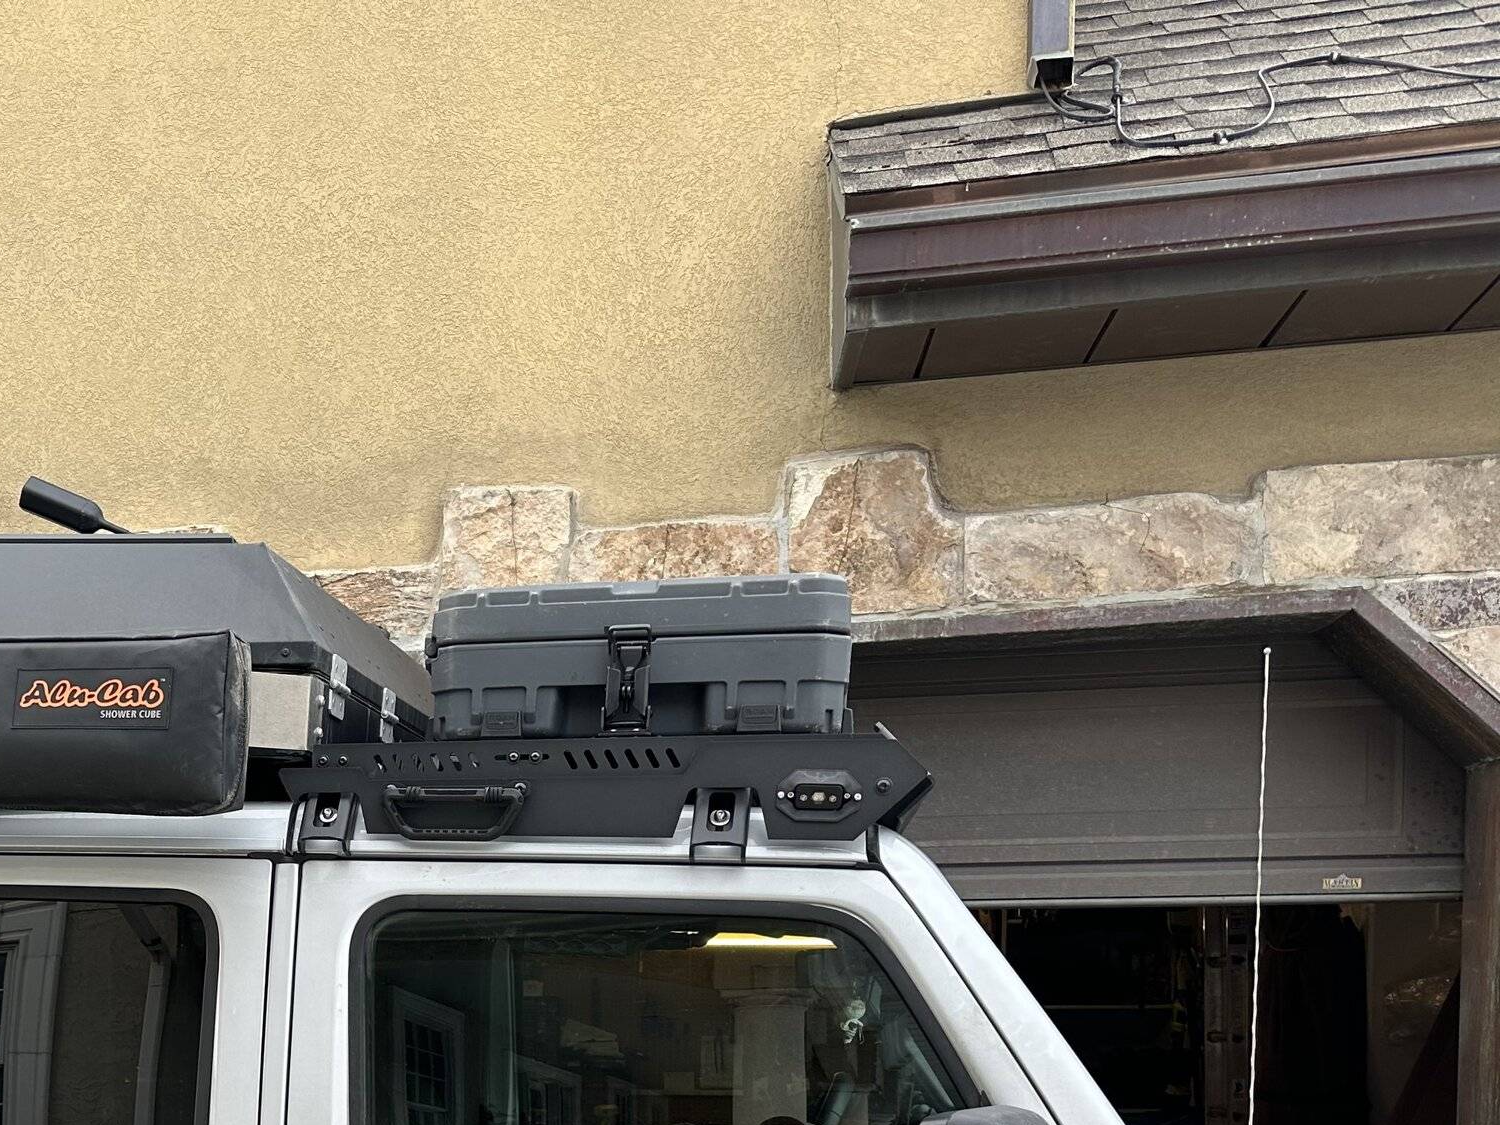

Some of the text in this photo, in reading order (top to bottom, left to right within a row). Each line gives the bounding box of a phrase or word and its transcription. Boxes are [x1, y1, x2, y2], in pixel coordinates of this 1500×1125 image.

[20, 679, 164, 708] Alu-Cab
[100, 709, 162, 719] SHOWER CUBE
